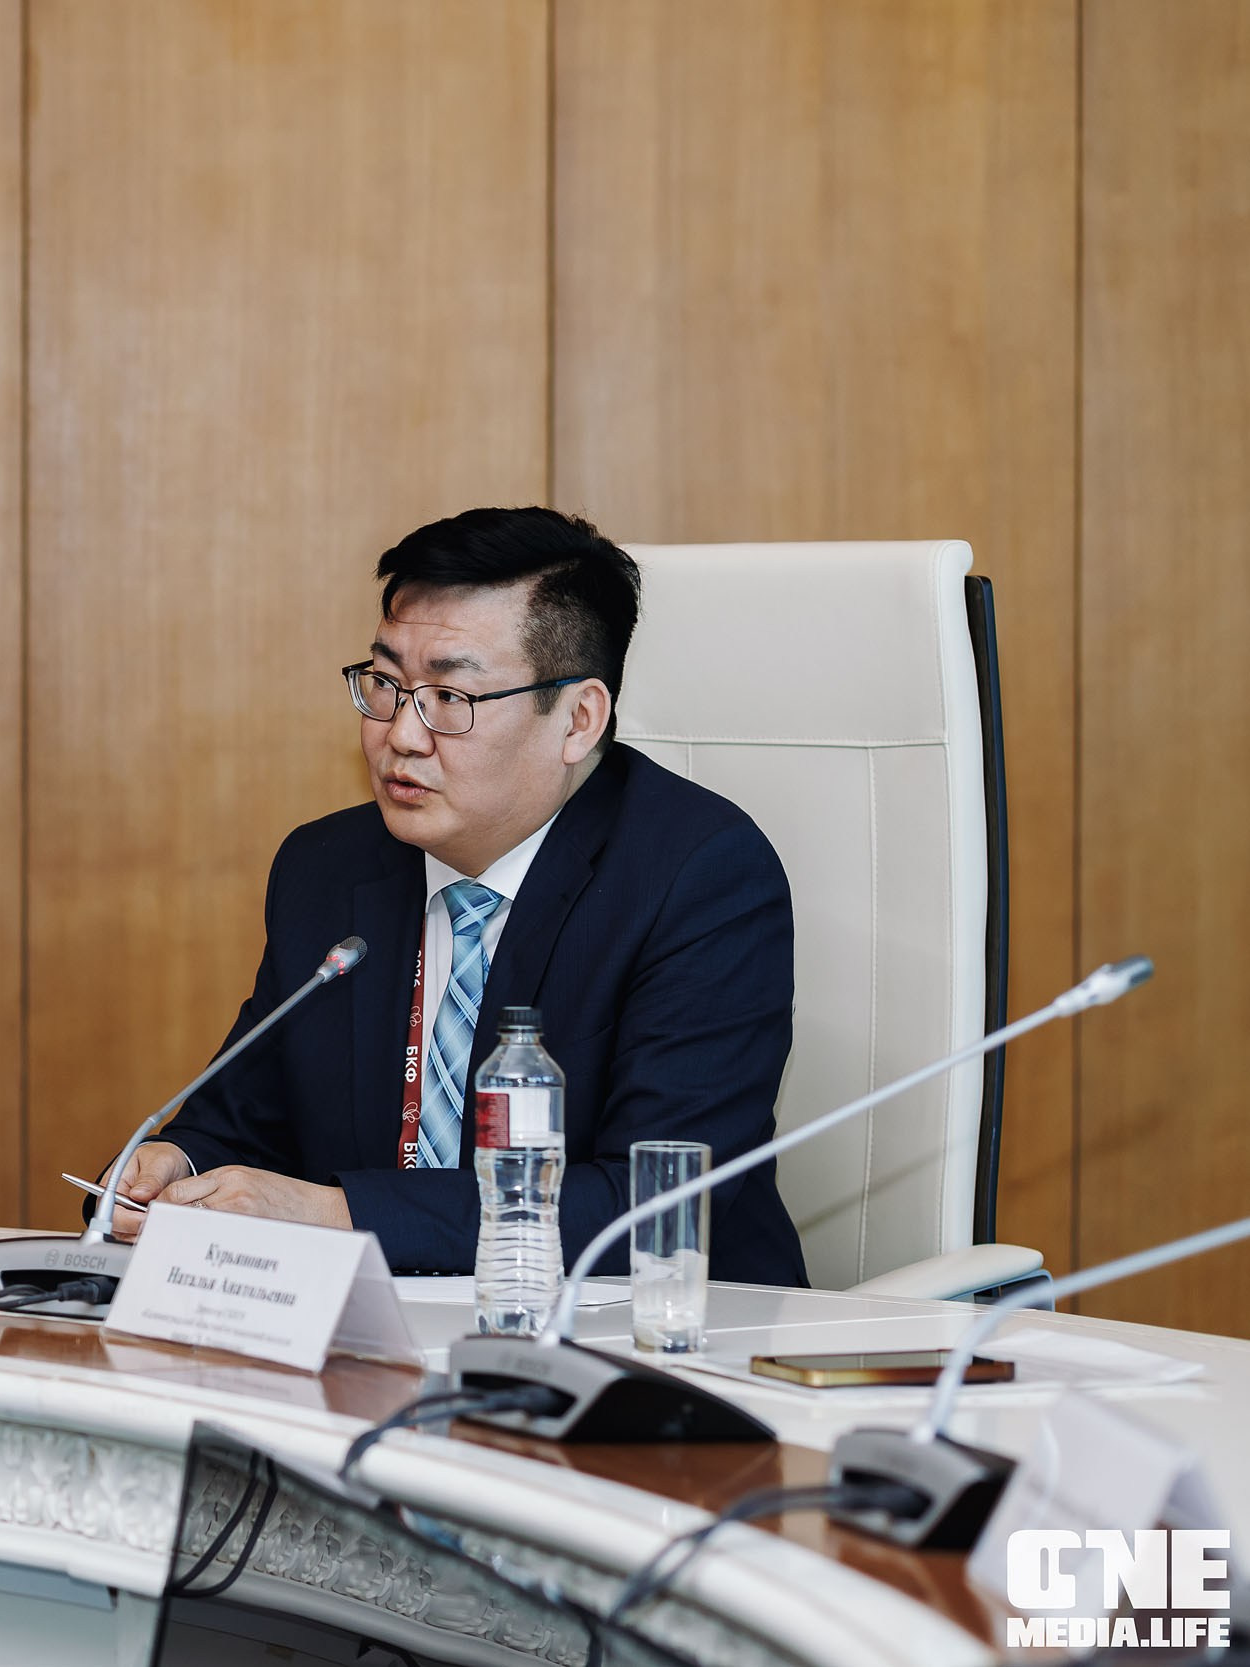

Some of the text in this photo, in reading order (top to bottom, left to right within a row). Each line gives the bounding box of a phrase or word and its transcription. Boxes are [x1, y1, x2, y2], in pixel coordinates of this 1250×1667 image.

[405, 1046, 418, 1083] БКФ
[403, 1142, 418, 1169] БК
[64, 1254, 108, 1270] BOSCH
[166, 1266, 216, 1290] Наталья
